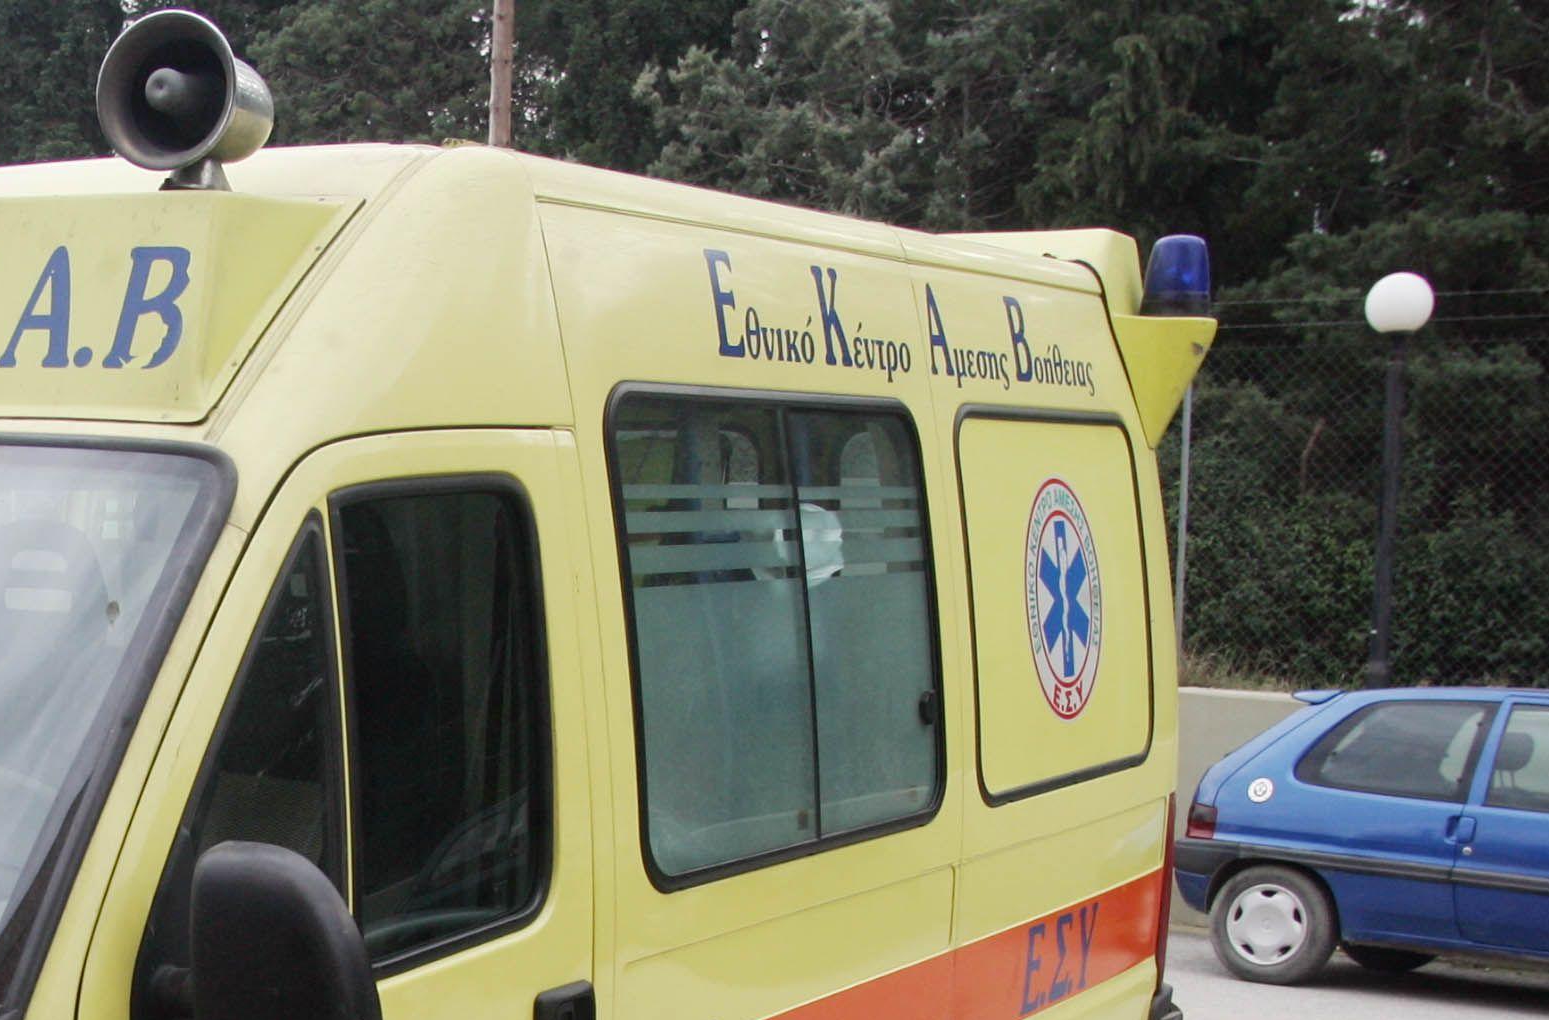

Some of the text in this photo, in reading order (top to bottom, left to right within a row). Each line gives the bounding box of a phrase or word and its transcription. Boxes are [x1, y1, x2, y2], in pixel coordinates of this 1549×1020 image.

[703, 248, 1095, 397] Εθνικό Κέντρο Αμεσης Βοήθειας
